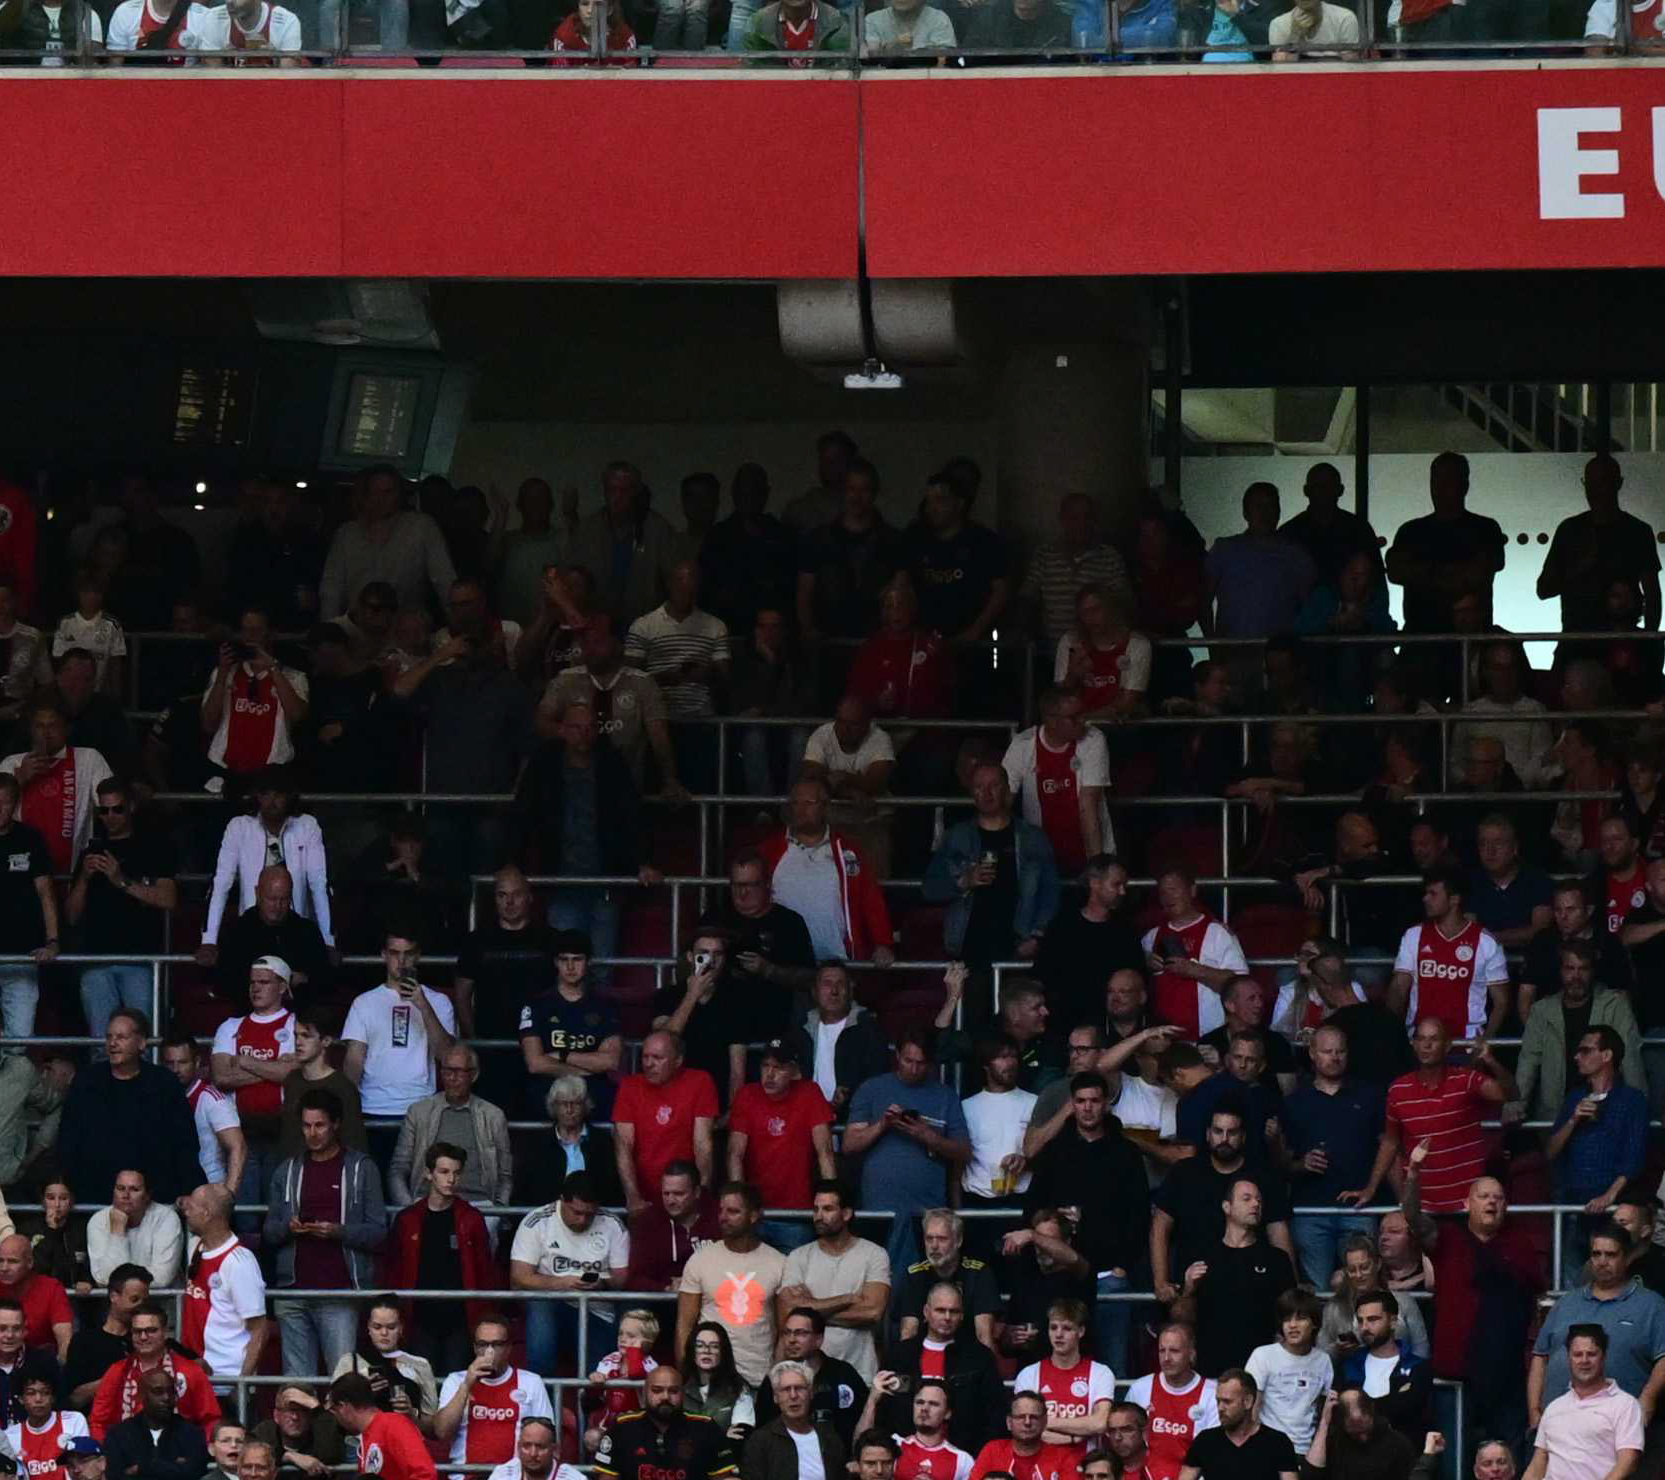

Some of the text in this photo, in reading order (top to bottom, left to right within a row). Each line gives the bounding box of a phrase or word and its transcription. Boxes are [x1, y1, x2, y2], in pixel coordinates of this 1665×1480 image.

[1419, 959, 1468, 979] Ziggo
[551, 1031, 597, 1048] Ziggo
[553, 1255, 602, 1272] Ziggo
[472, 1405, 515, 1420] Ziggo
[1151, 1418, 1190, 1434] Ziggo
[28, 1459, 59, 1473] Zigg
